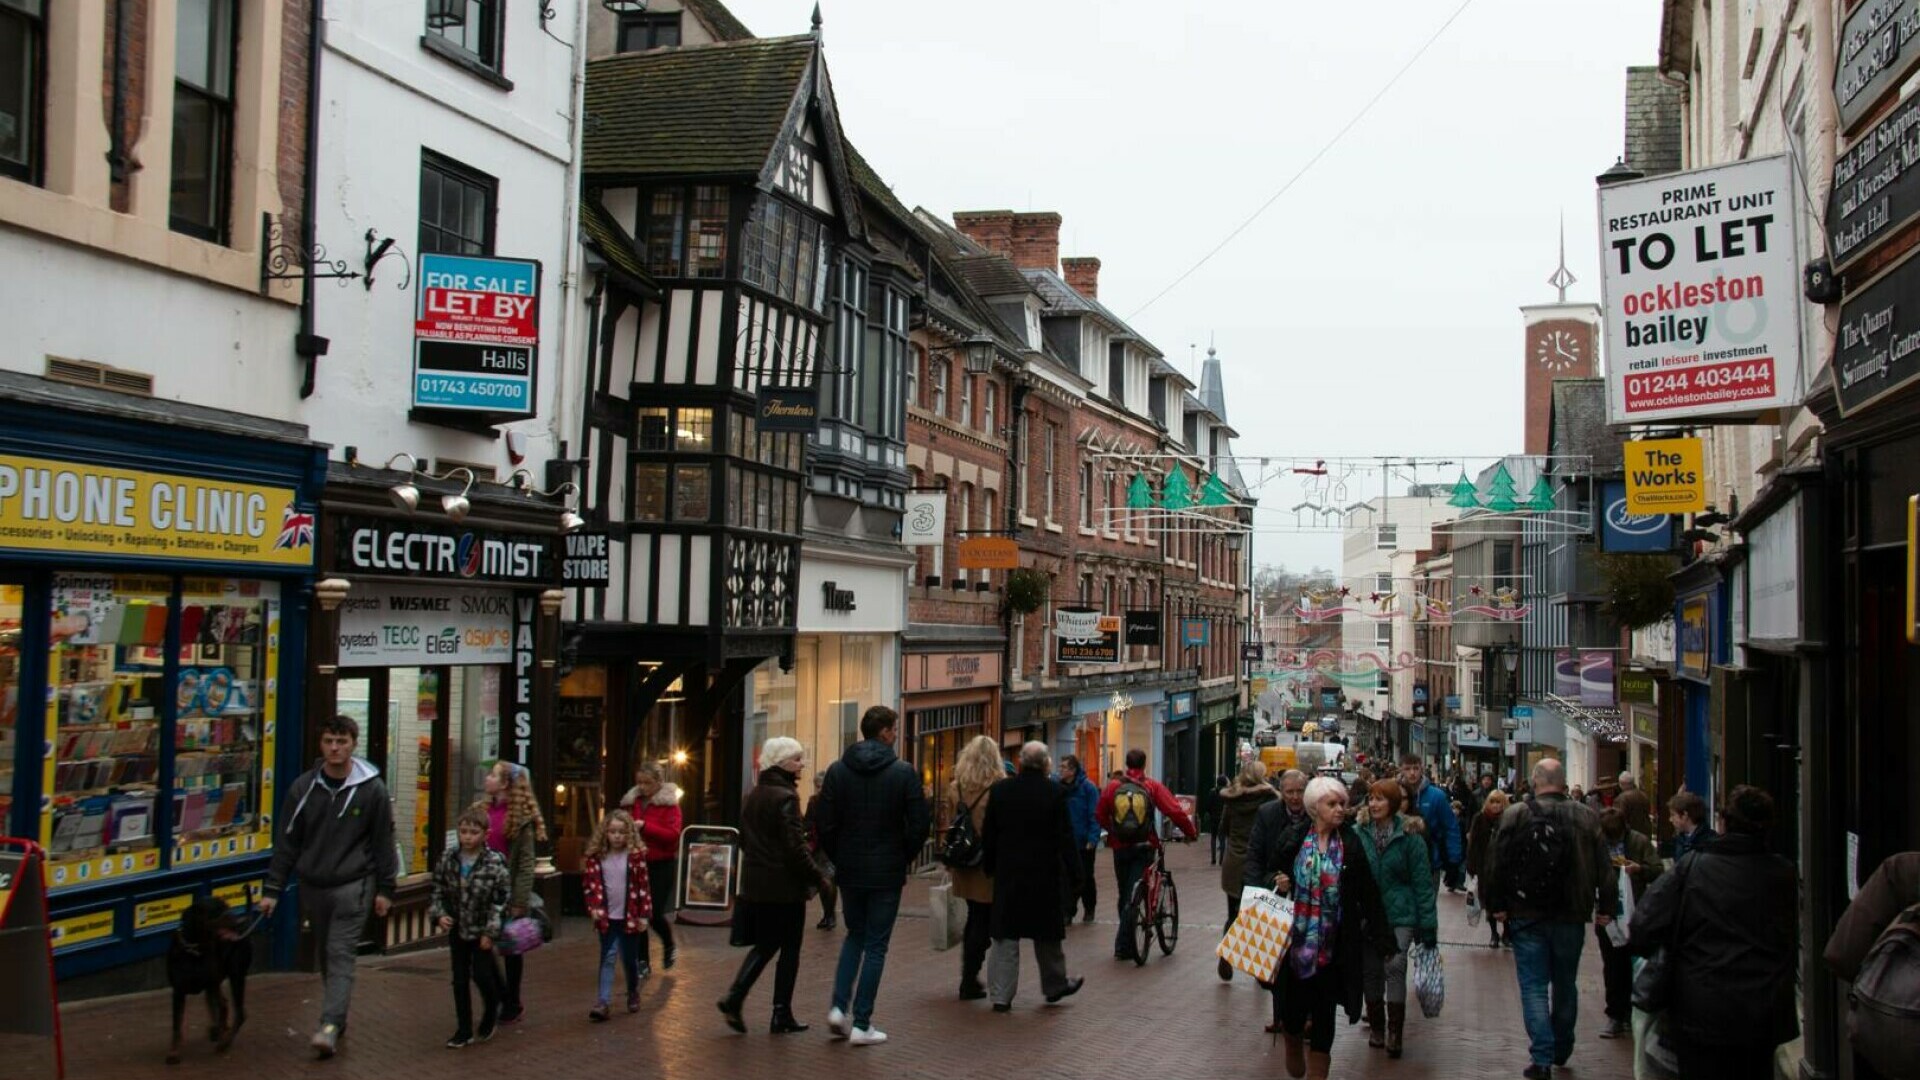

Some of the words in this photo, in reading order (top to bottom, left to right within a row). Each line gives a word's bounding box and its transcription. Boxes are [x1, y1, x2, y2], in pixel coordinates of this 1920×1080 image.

[1835, 153, 1859, 189] Pride
[1858, 131, 1876, 169] Hill
[1857, 153, 1900, 204] Riverside
[1662, 183, 1716, 205] PRIME
[1609, 200, 1722, 232] RESTAURANT
[1728, 190, 1775, 212] UNIT
[1835, 222, 1866, 258] Market
[1867, 196, 1889, 234] Hall
[1612, 232, 1675, 274] TO
[1695, 214, 1774, 263] LET
[427, 272, 469, 291] FOR
[473, 276, 527, 295] SALE
[1623, 274, 1764, 316] ockleston
[428, 290, 485, 315] LET
[494, 296, 532, 319] BY
[435, 322, 453, 330] NOW
[454, 323, 497, 333] BENEFITING
[498, 326, 518, 335] FROM
[466, 332, 502, 342] PLANNING
[502, 335, 537, 345] CONSENT
[1625, 315, 1708, 348] bailey
[1843, 324, 1860, 349] The
[1860, 304, 1895, 346] Quarry
[481, 350, 526, 370] Halls
[1629, 353, 1658, 370] retail
[1662, 353, 1699, 367] leisure
[1703, 344, 1768, 361] investment
[1843, 348, 1889, 389] Swimming
[421, 378, 466, 394] 01743
[468, 381, 522, 398] 450700
[1629, 374, 1689, 395] 01244
[1694, 363, 1770, 386] 403444
[1630, 384, 1770, 408] www.ocklestonbailey.co.uk
[1645, 450, 1683, 467] The
[1633, 469, 1697, 487] Works
[0, 465, 136, 527] PHONE
[150, 482, 266, 537] CLINIC
[65, 528, 114, 546] Unlocking
[124, 532, 167, 550] Repairing
[177, 536, 215, 550] Batteries
[224, 540, 258, 555] Chargers
[565, 535, 606, 556] VAPE
[563, 559, 608, 580] STORE
[460, 595, 511, 616] SMOK
[382, 625, 420, 645] TECC
[426, 635, 461, 654] Eleaf
[516, 597, 533, 703] VAPE
